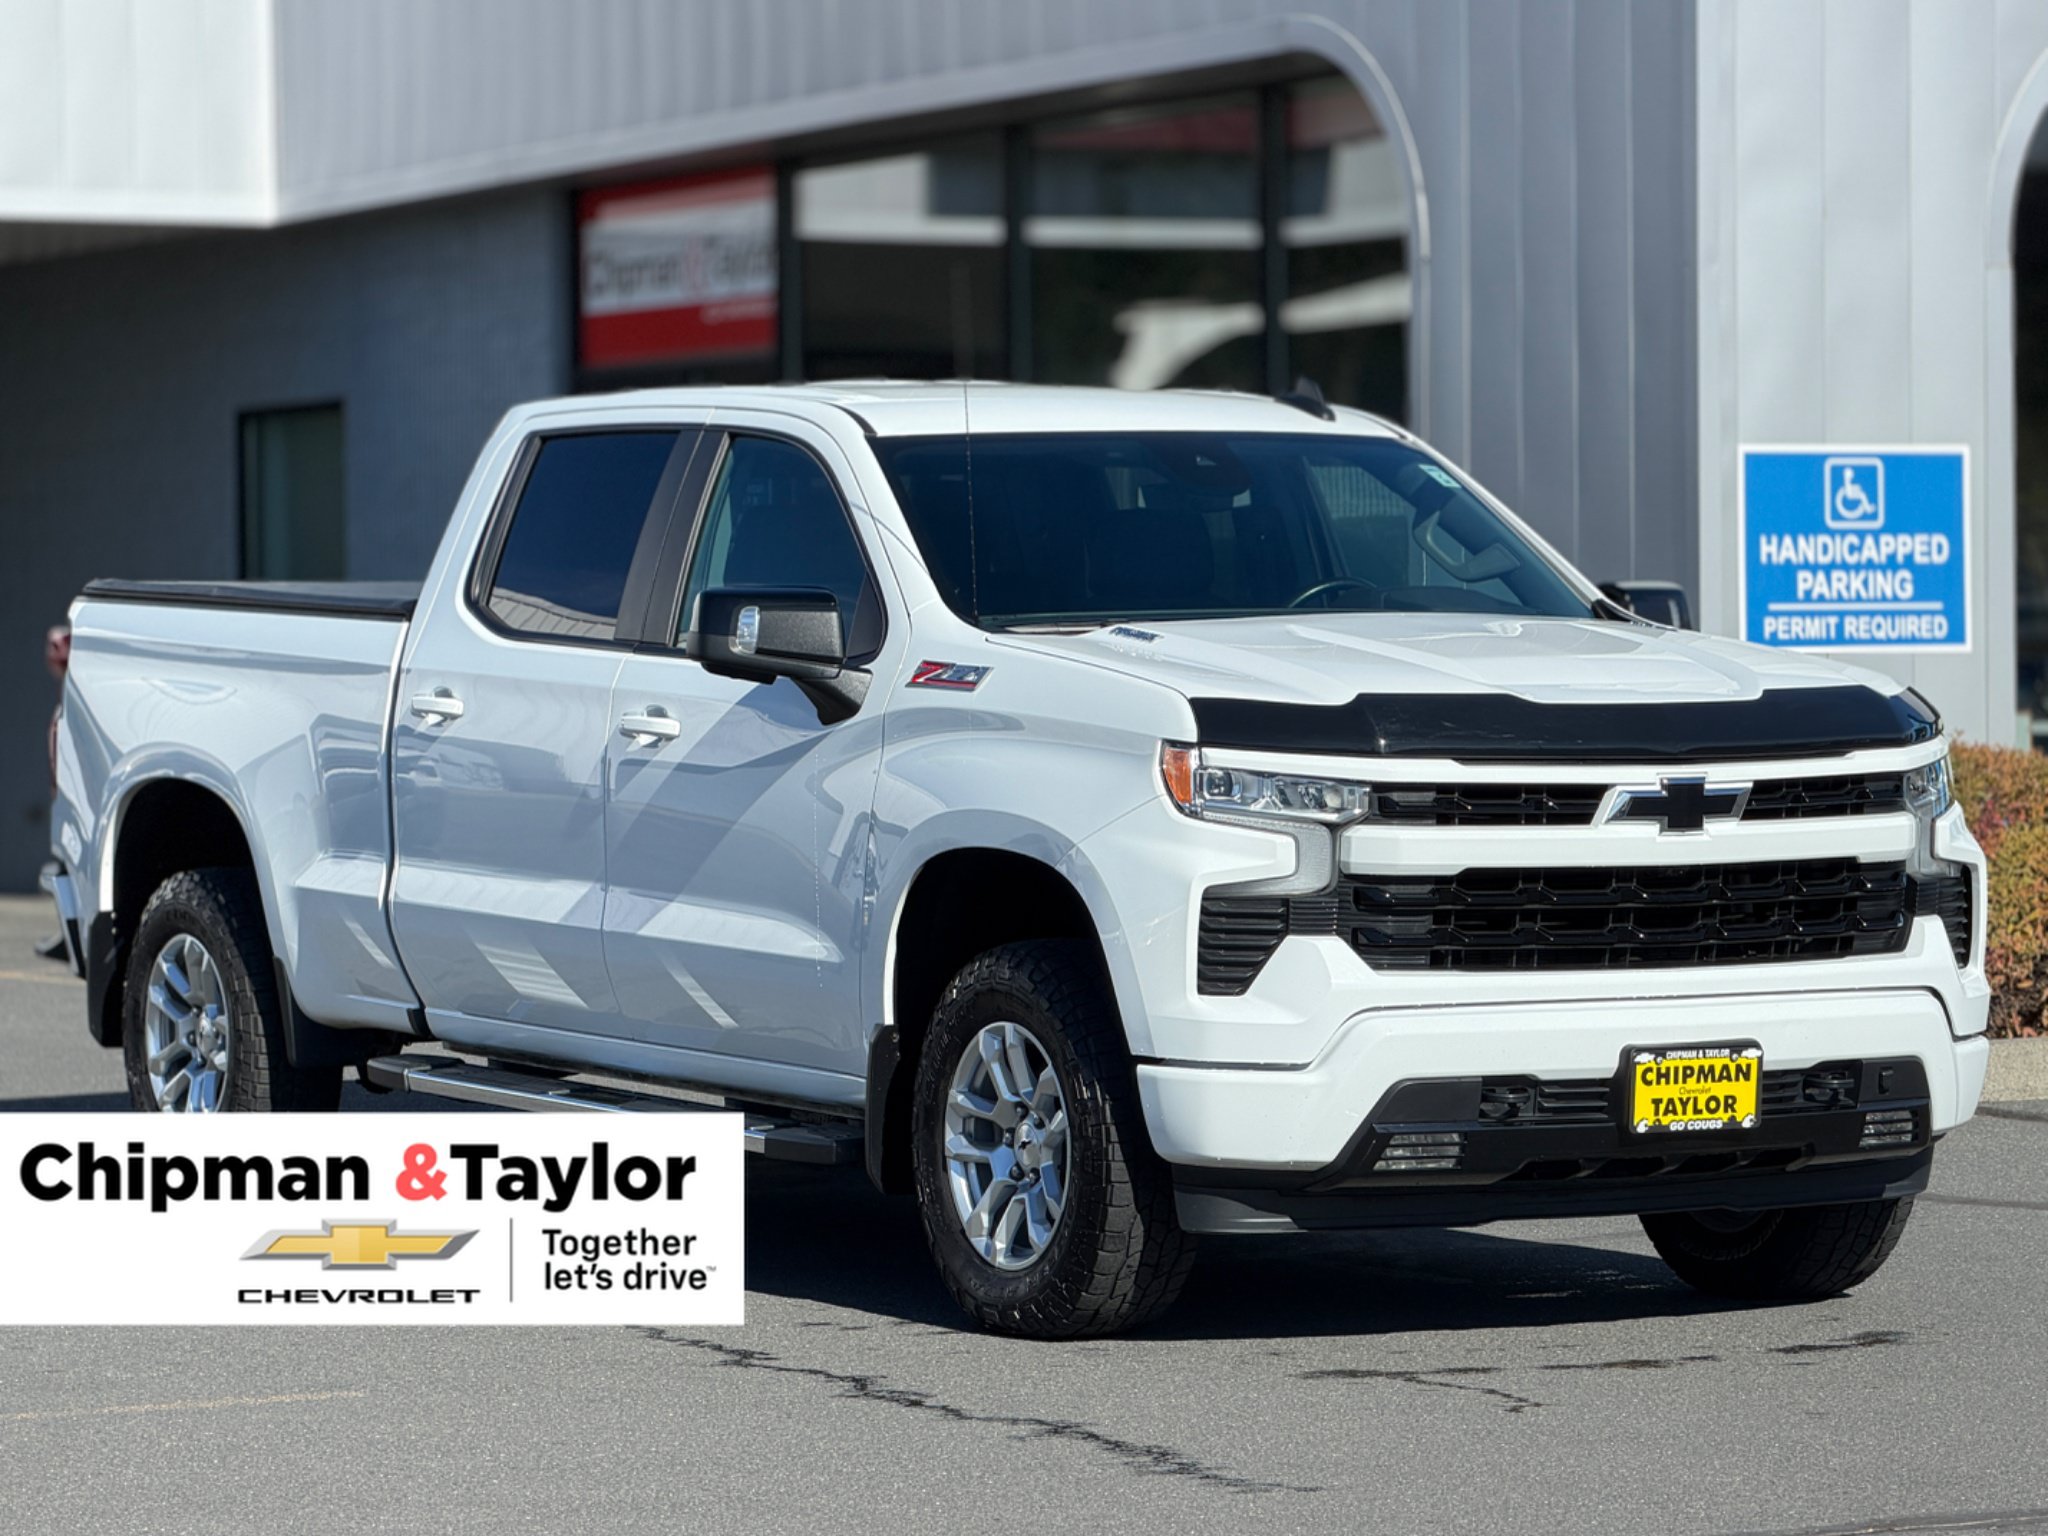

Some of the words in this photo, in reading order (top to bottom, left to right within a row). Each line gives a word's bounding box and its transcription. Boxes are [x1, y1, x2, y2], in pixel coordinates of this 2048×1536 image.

[1760, 534, 1950, 564] HANDICAPPED
[1797, 570, 1914, 600] PARKING
[1764, 616, 1839, 640] PERMIT
[1845, 615, 1949, 641] REQUIRED
[1641, 1063, 1752, 1086] CHIPMAN
[1651, 1095, 1738, 1117] TAYLOR
[1669, 1120, 1685, 1131] GO
[1687, 1119, 1723, 1130] COUGS
